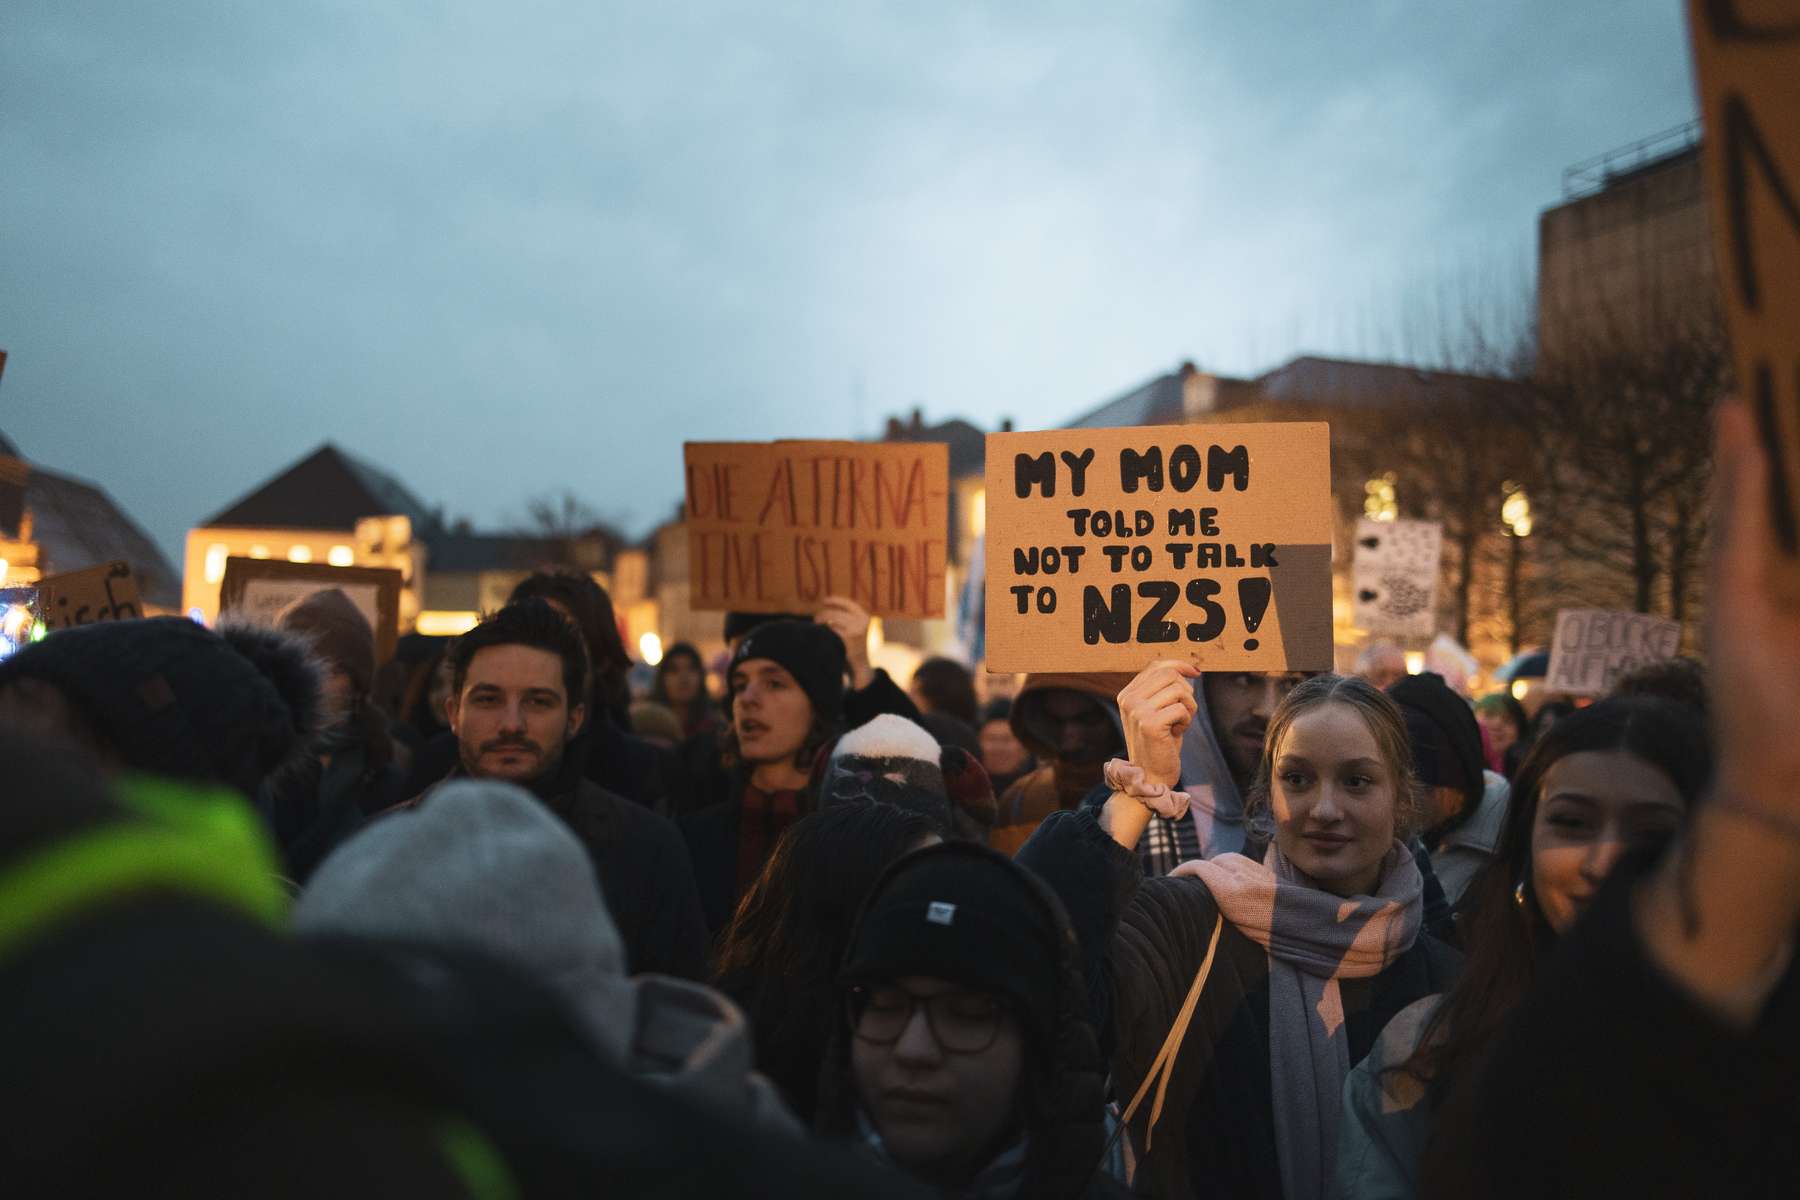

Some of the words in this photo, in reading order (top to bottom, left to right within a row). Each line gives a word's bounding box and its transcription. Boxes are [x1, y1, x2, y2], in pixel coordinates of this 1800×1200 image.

[686, 460, 744, 524] DIE
[1014, 447, 1095, 499] MY
[1119, 444, 1250, 494] MOM
[1066, 508, 1155, 538] TOLD
[1168, 507, 1221, 537] ME
[691, 529, 774, 603] TIVE
[794, 534, 833, 603] IST
[850, 537, 946, 616] KEINE
[1013, 545, 1086, 575] NOT
[1102, 545, 1152, 573] TO
[1165, 542, 1280, 570] TALK
[1009, 585, 1057, 614] TO
[1082, 576, 1272, 651] NZS!
